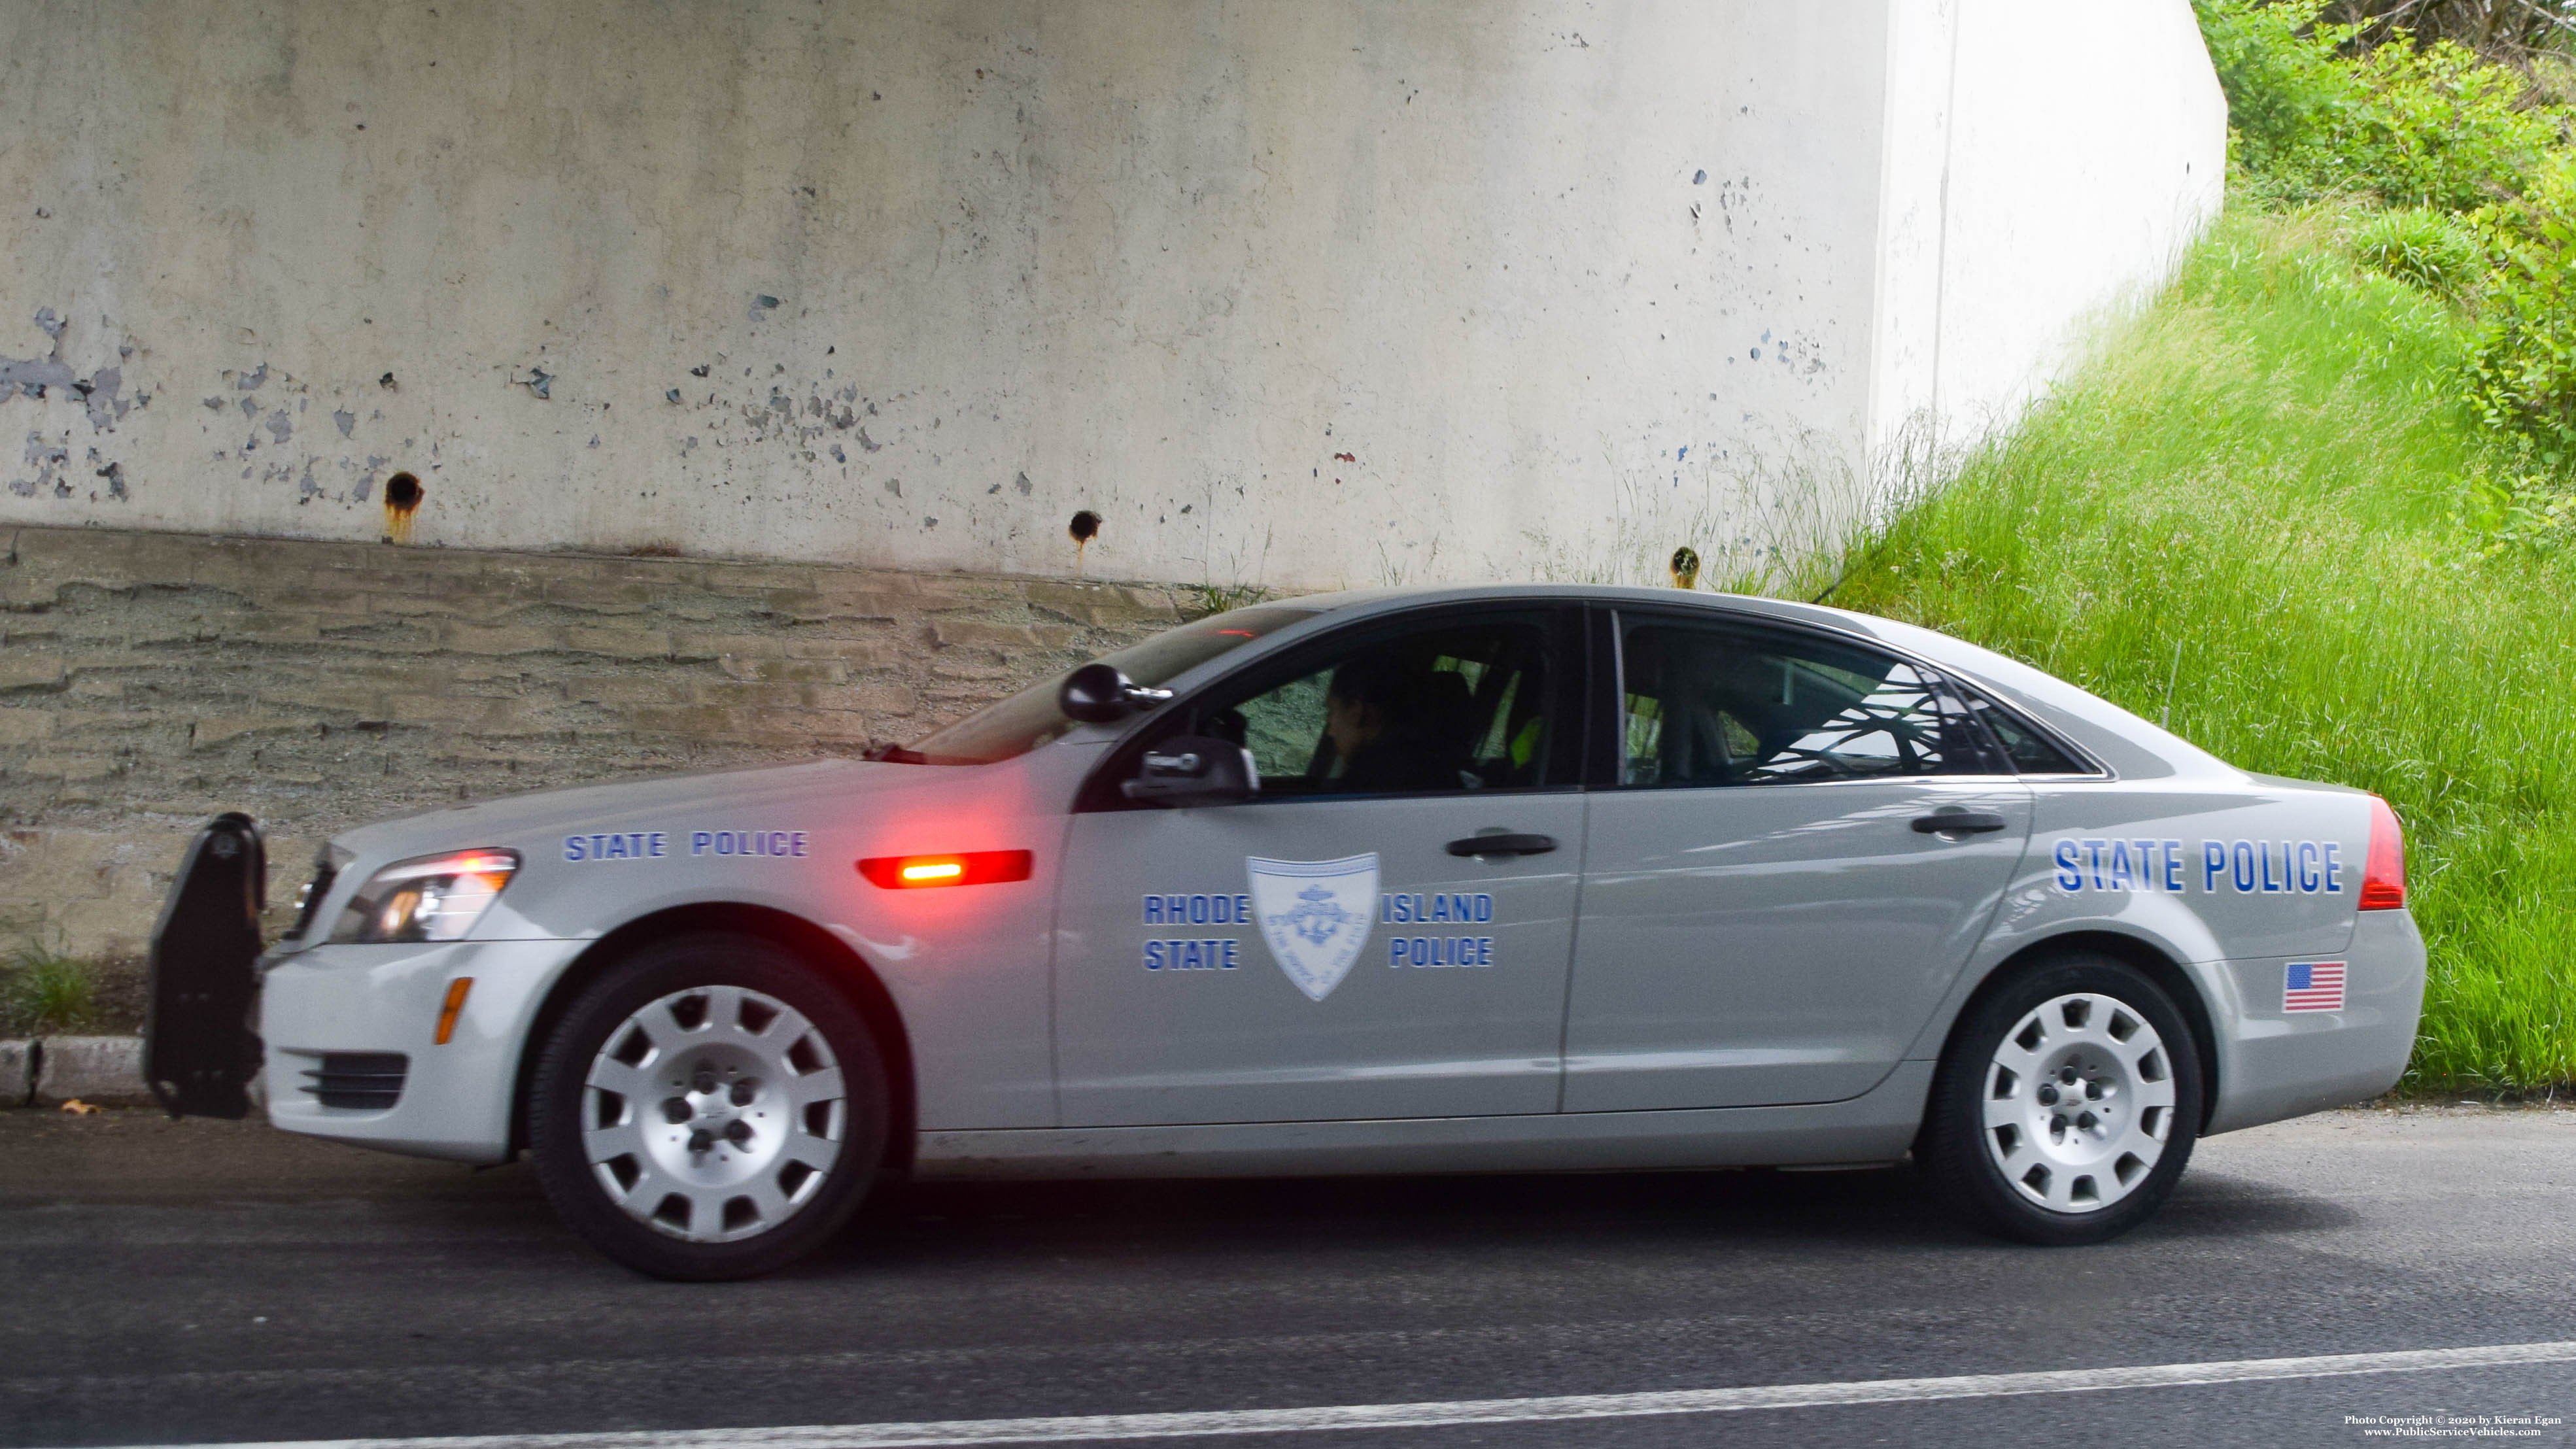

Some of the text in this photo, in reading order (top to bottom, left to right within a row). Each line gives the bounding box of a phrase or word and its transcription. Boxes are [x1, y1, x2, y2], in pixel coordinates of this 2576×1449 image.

[565, 831, 808, 861] STATE POLICE
[2053, 838, 2343, 894] STATE POLICE
[1142, 893, 1493, 925] RHODE ISLAND
[1142, 940, 1239, 970] STATE
[1389, 937, 1493, 967] POLICE
